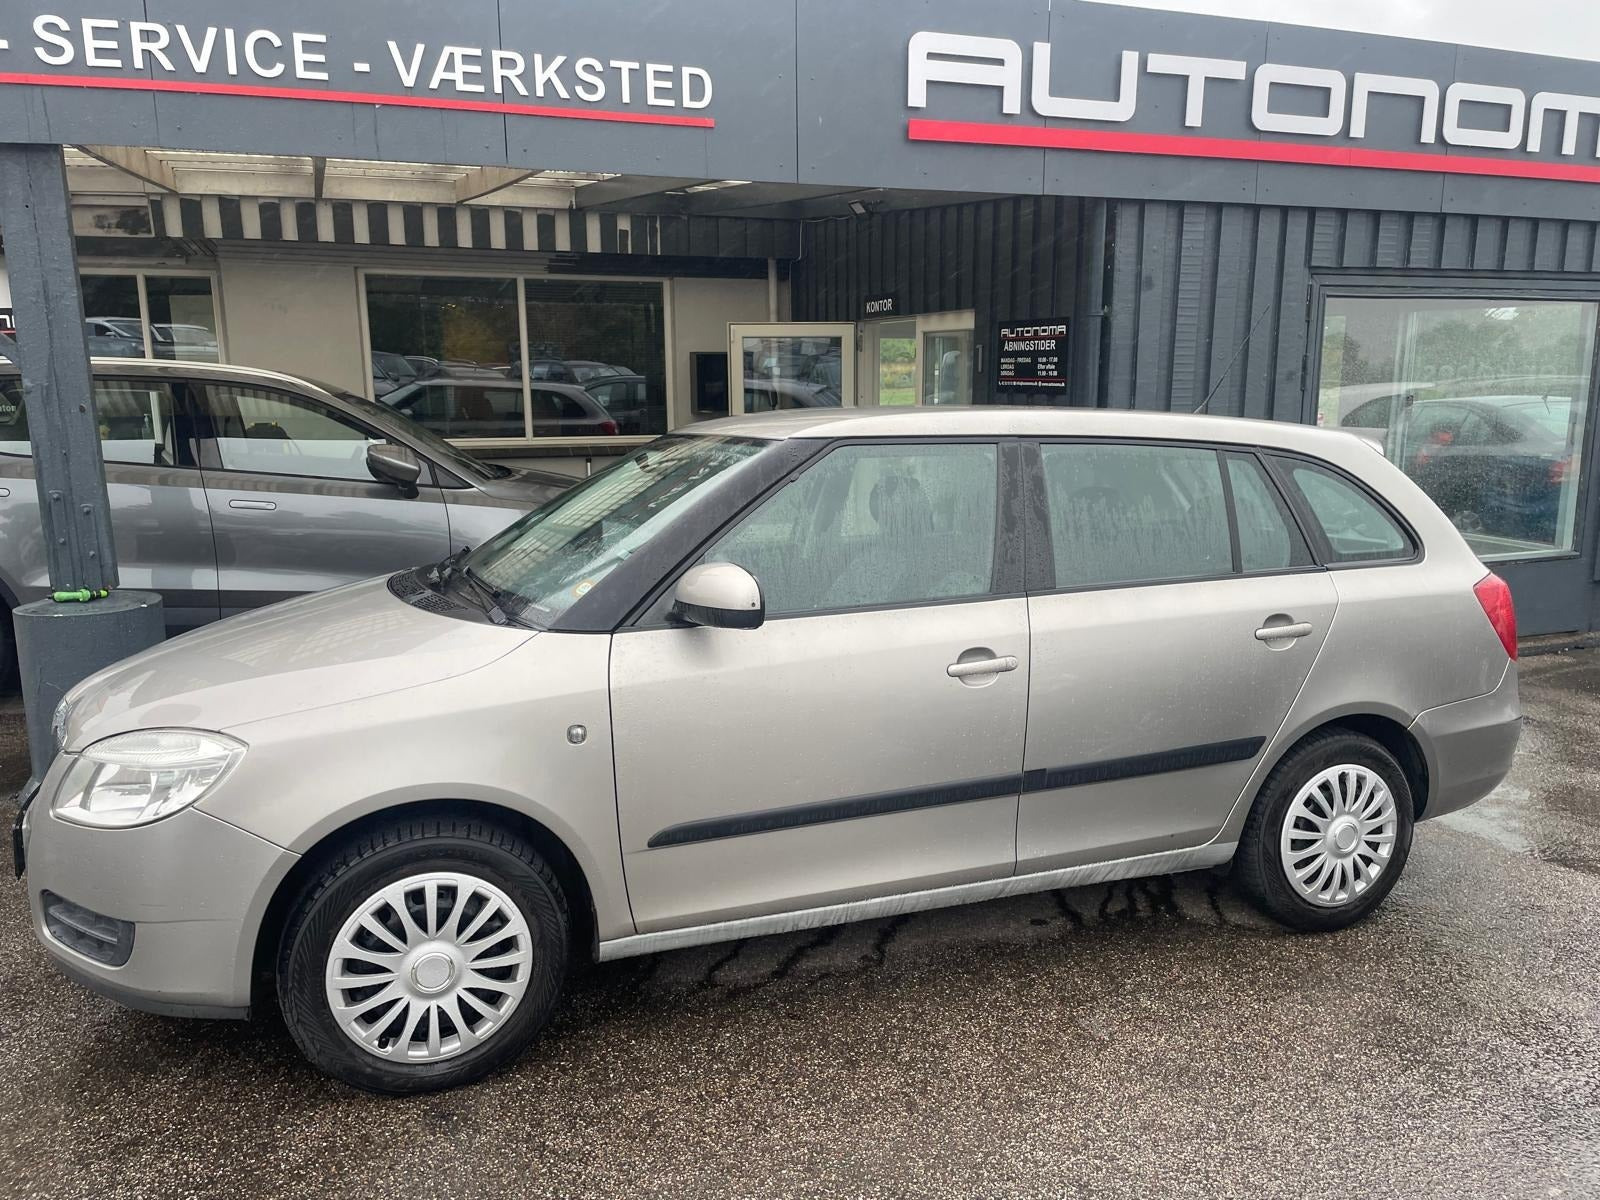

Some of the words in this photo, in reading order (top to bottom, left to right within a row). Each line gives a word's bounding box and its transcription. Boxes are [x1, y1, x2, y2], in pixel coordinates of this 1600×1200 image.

[32, 13, 330, 81] SERVICE
[387, 40, 714, 110] VÆRKSTED
[866, 298, 893, 313] KONTOR
[1001, 325, 1066, 337] AUTONOMA
[1004, 340, 1056, 351] ÅBNINGSTIDER
